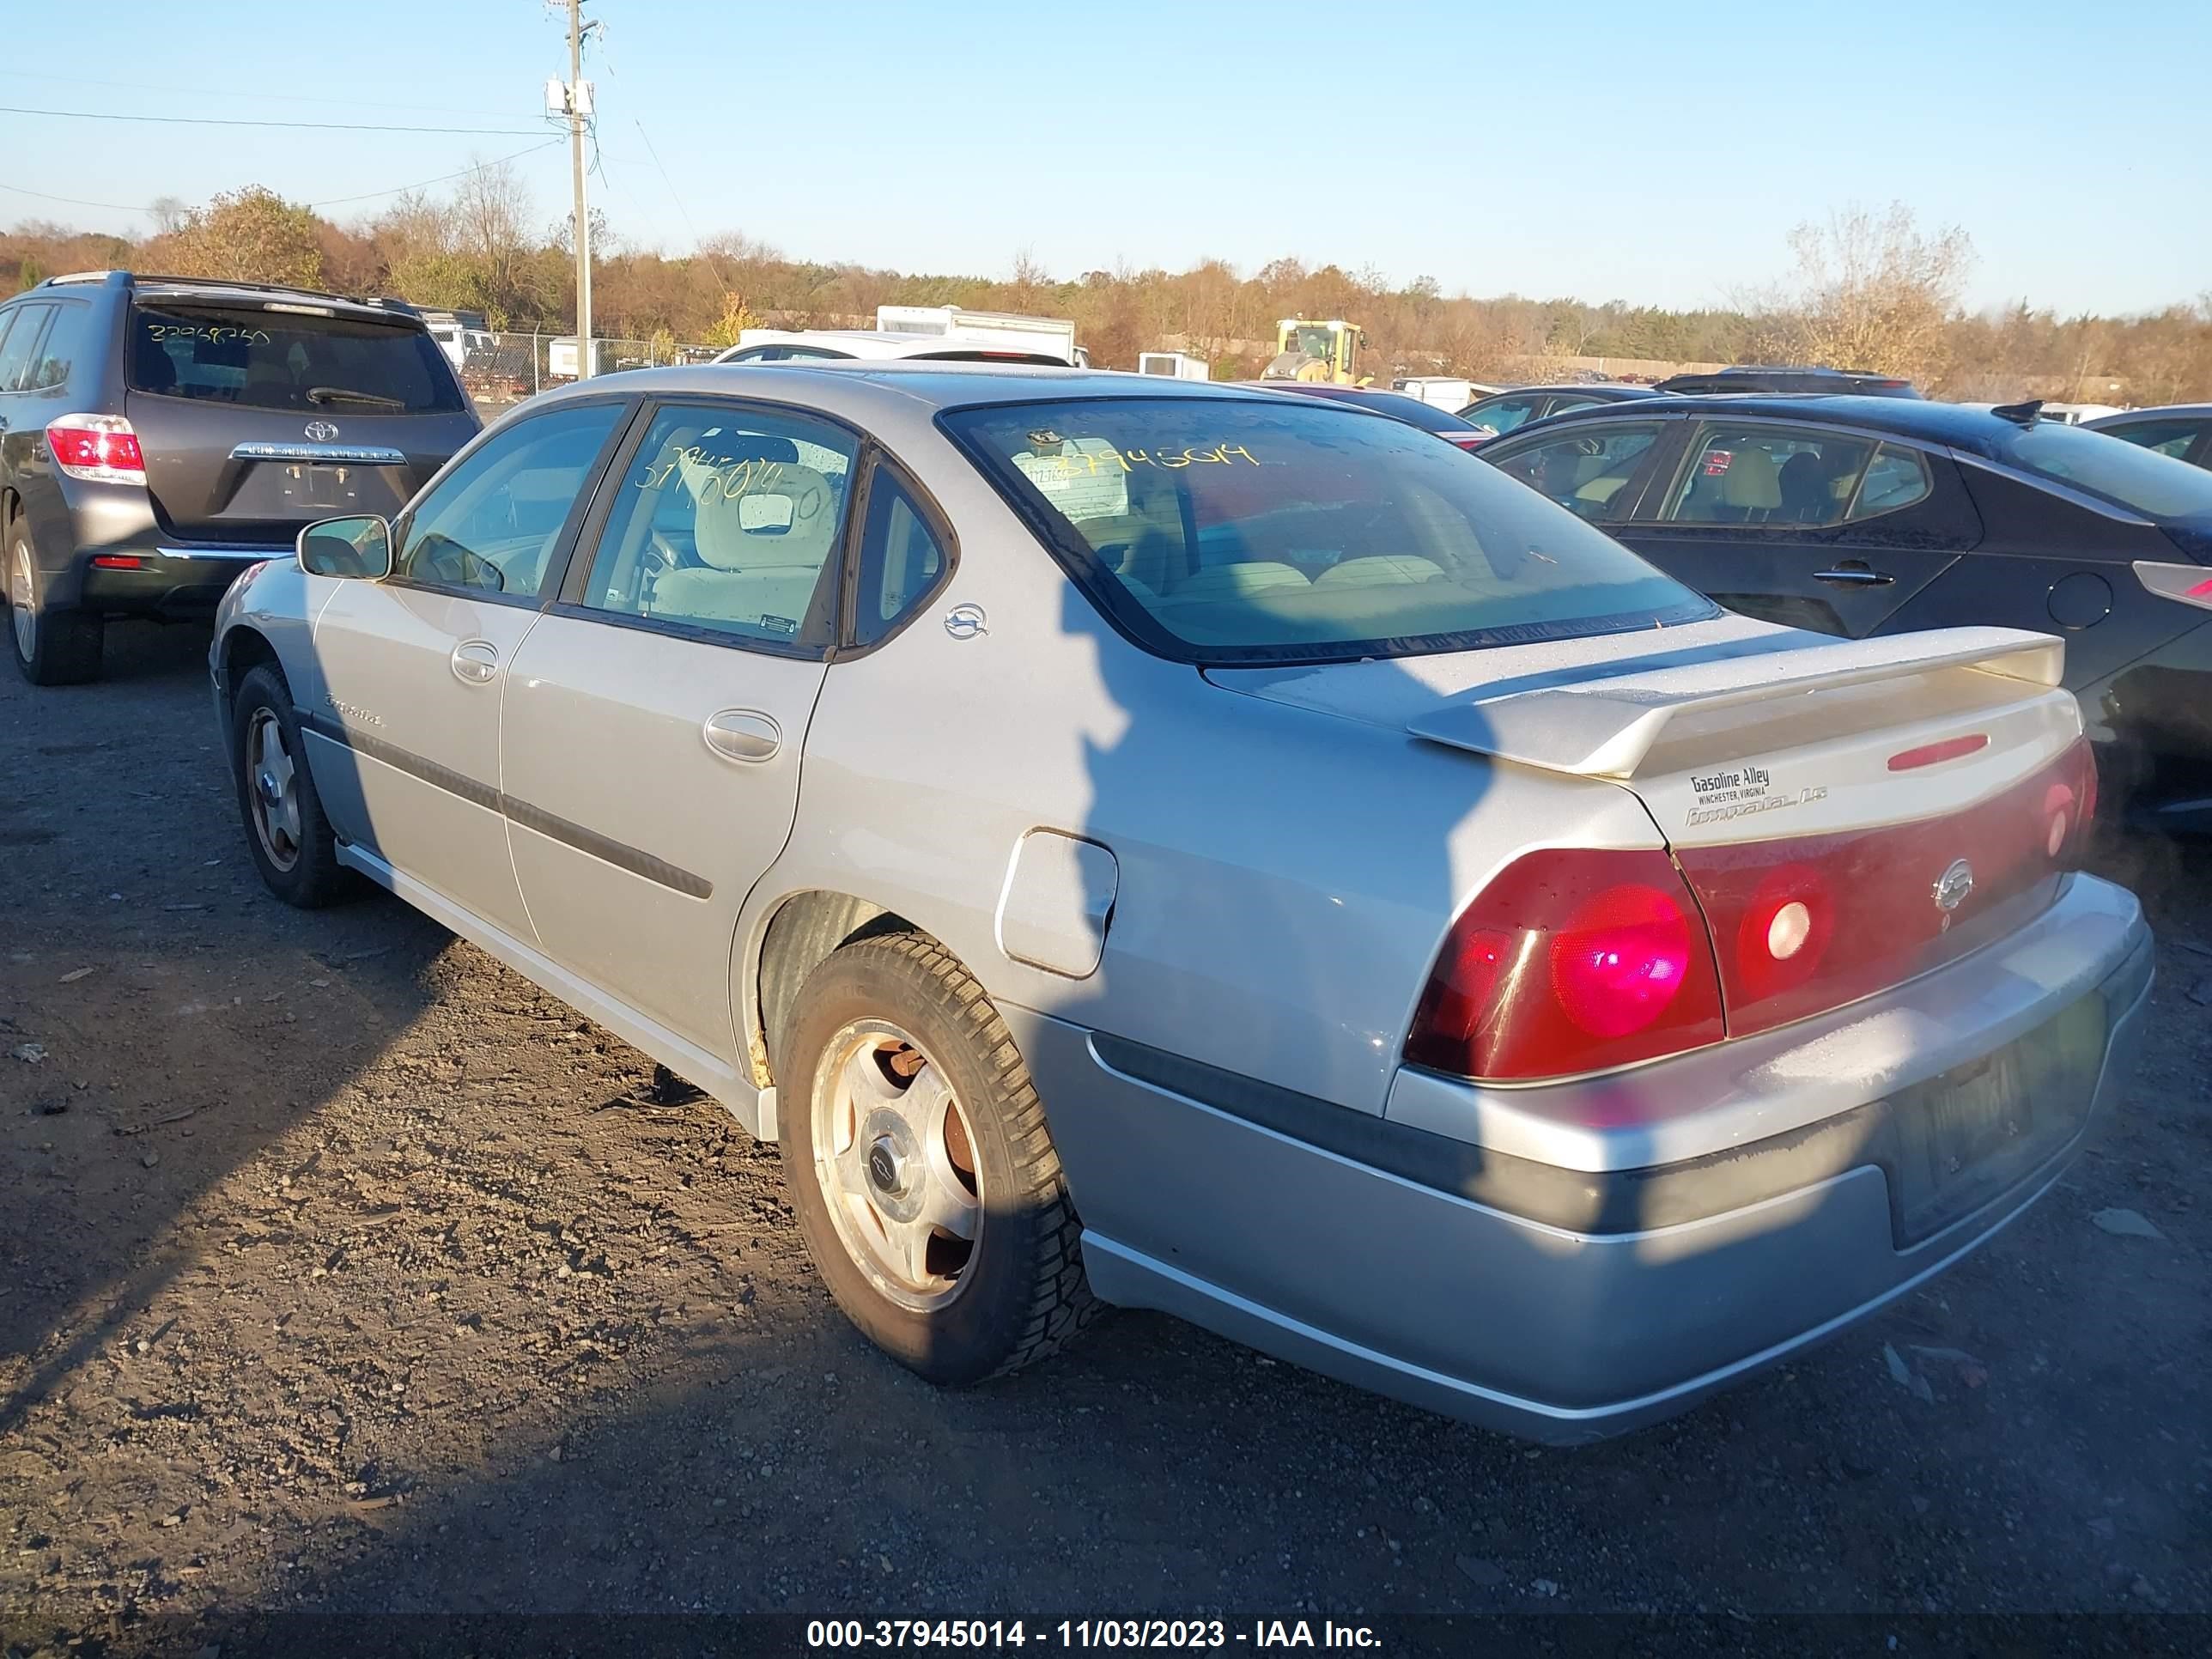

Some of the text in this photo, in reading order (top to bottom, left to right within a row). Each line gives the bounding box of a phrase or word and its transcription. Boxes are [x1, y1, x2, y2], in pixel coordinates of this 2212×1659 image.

[1691, 767, 1770, 793] Gasoline Alley
[1698, 787, 1765, 805] WINCHESTER, VIRGINIA
